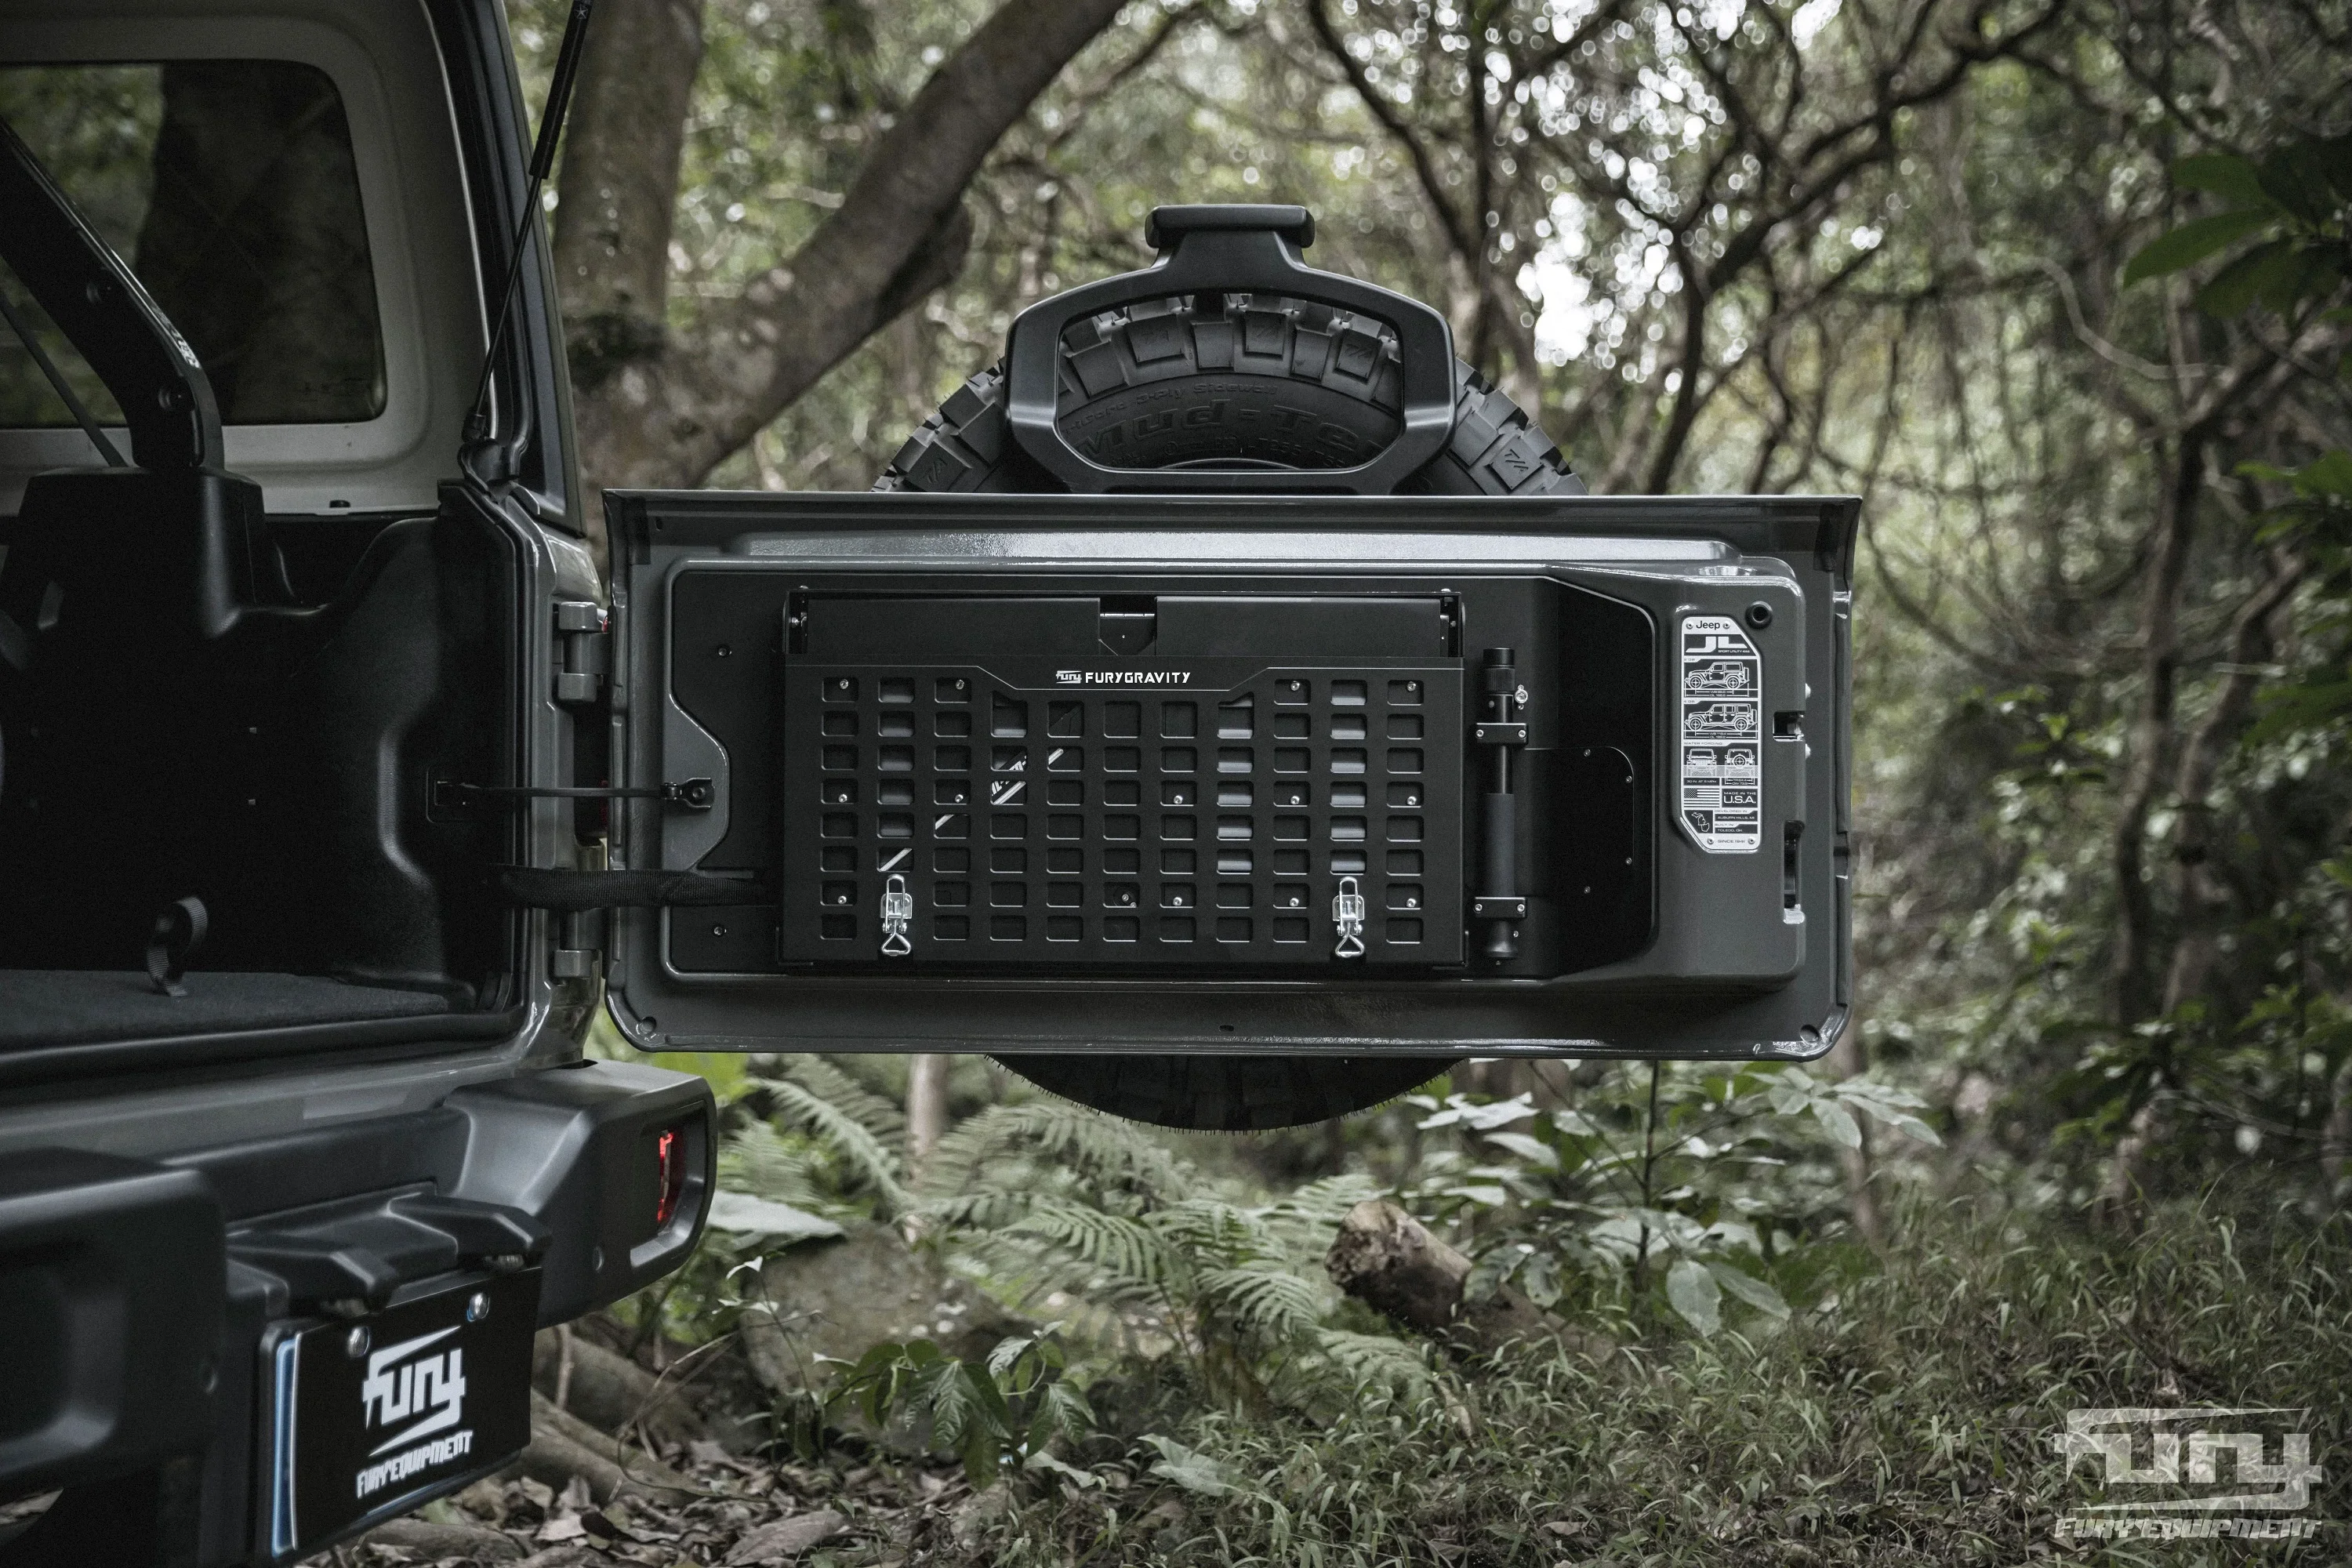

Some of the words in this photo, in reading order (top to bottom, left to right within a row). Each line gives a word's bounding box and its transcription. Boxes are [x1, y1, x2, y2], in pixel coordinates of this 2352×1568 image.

[1696, 621, 1721, 630] Jeep
[1686, 637, 1748, 653] JL
[1085, 672, 1191, 684] FURYGRAVITY
[1723, 795, 1756, 804] U.S.A.
